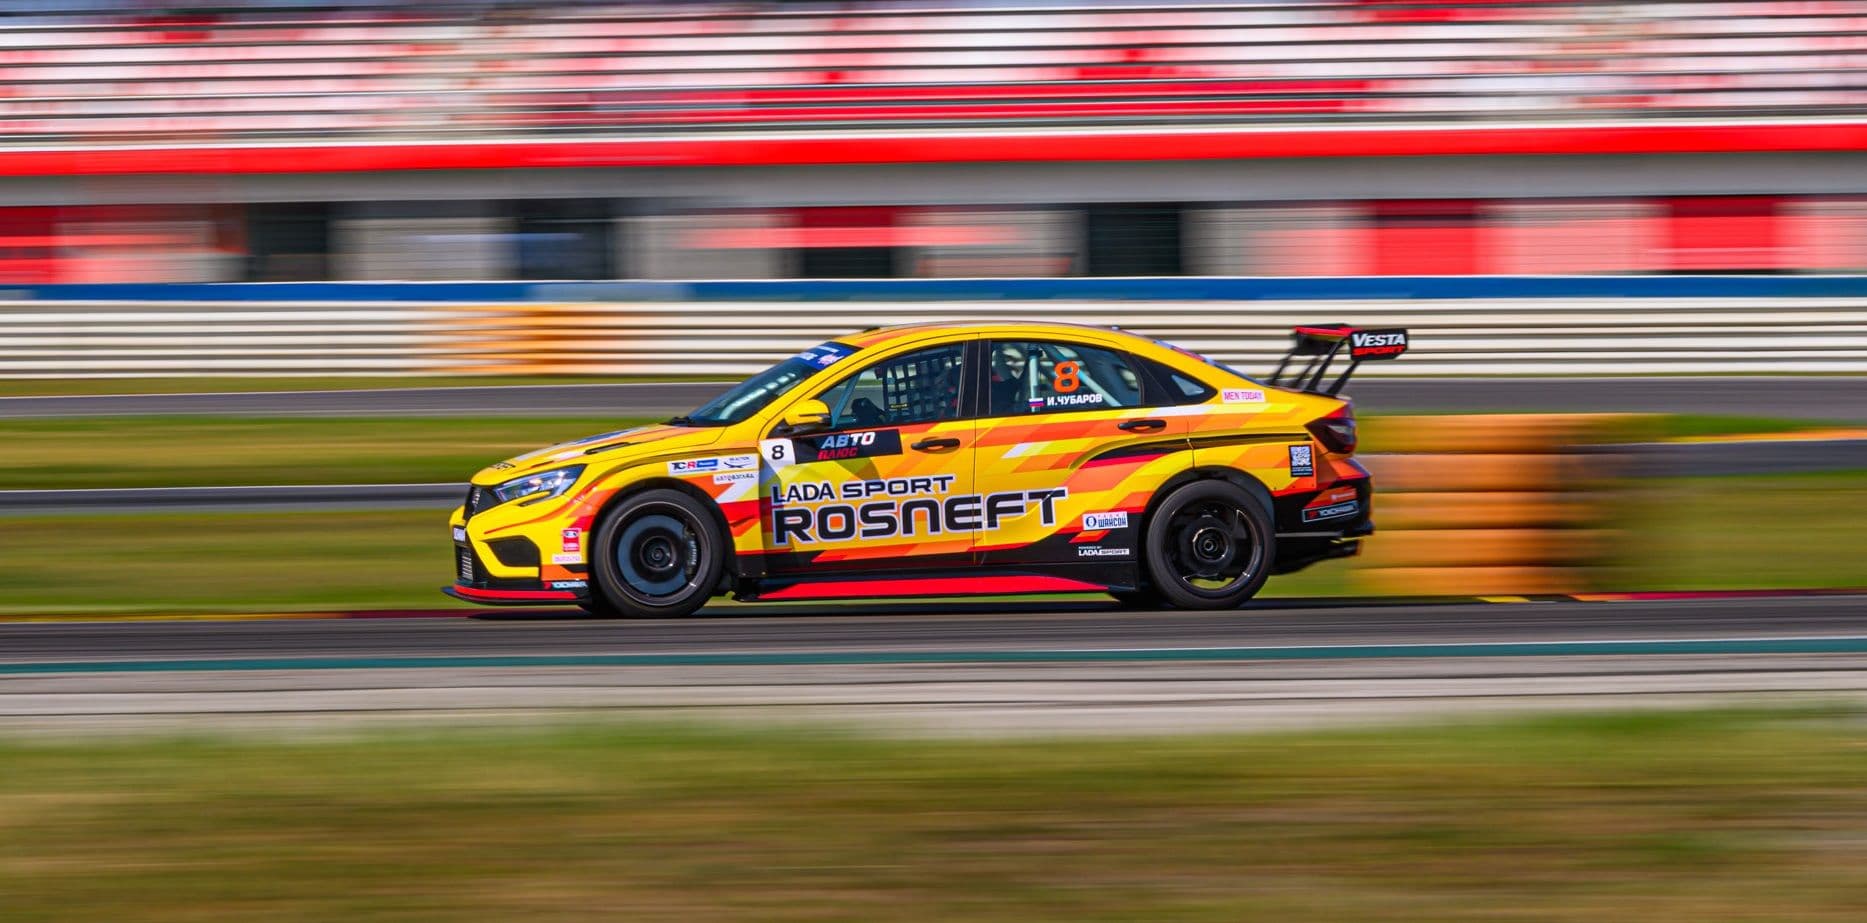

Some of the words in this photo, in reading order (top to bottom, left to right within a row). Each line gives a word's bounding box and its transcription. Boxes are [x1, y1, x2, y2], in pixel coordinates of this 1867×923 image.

[1352, 333, 1406, 347] VESTA
[1053, 361, 1080, 393] 8
[1047, 394, 1102, 406] И.ЧУБАРОВ
[1224, 391, 1240, 401] MEN
[1241, 391, 1262, 400] TODAY
[820, 431, 876, 449] АВТО
[771, 445, 785, 459] 8
[772, 482, 835, 504] LADA
[842, 476, 954, 499] SPORT
[774, 488, 1066, 544] ROSNEFT
[1098, 517, 1127, 527] ШАНСОН
